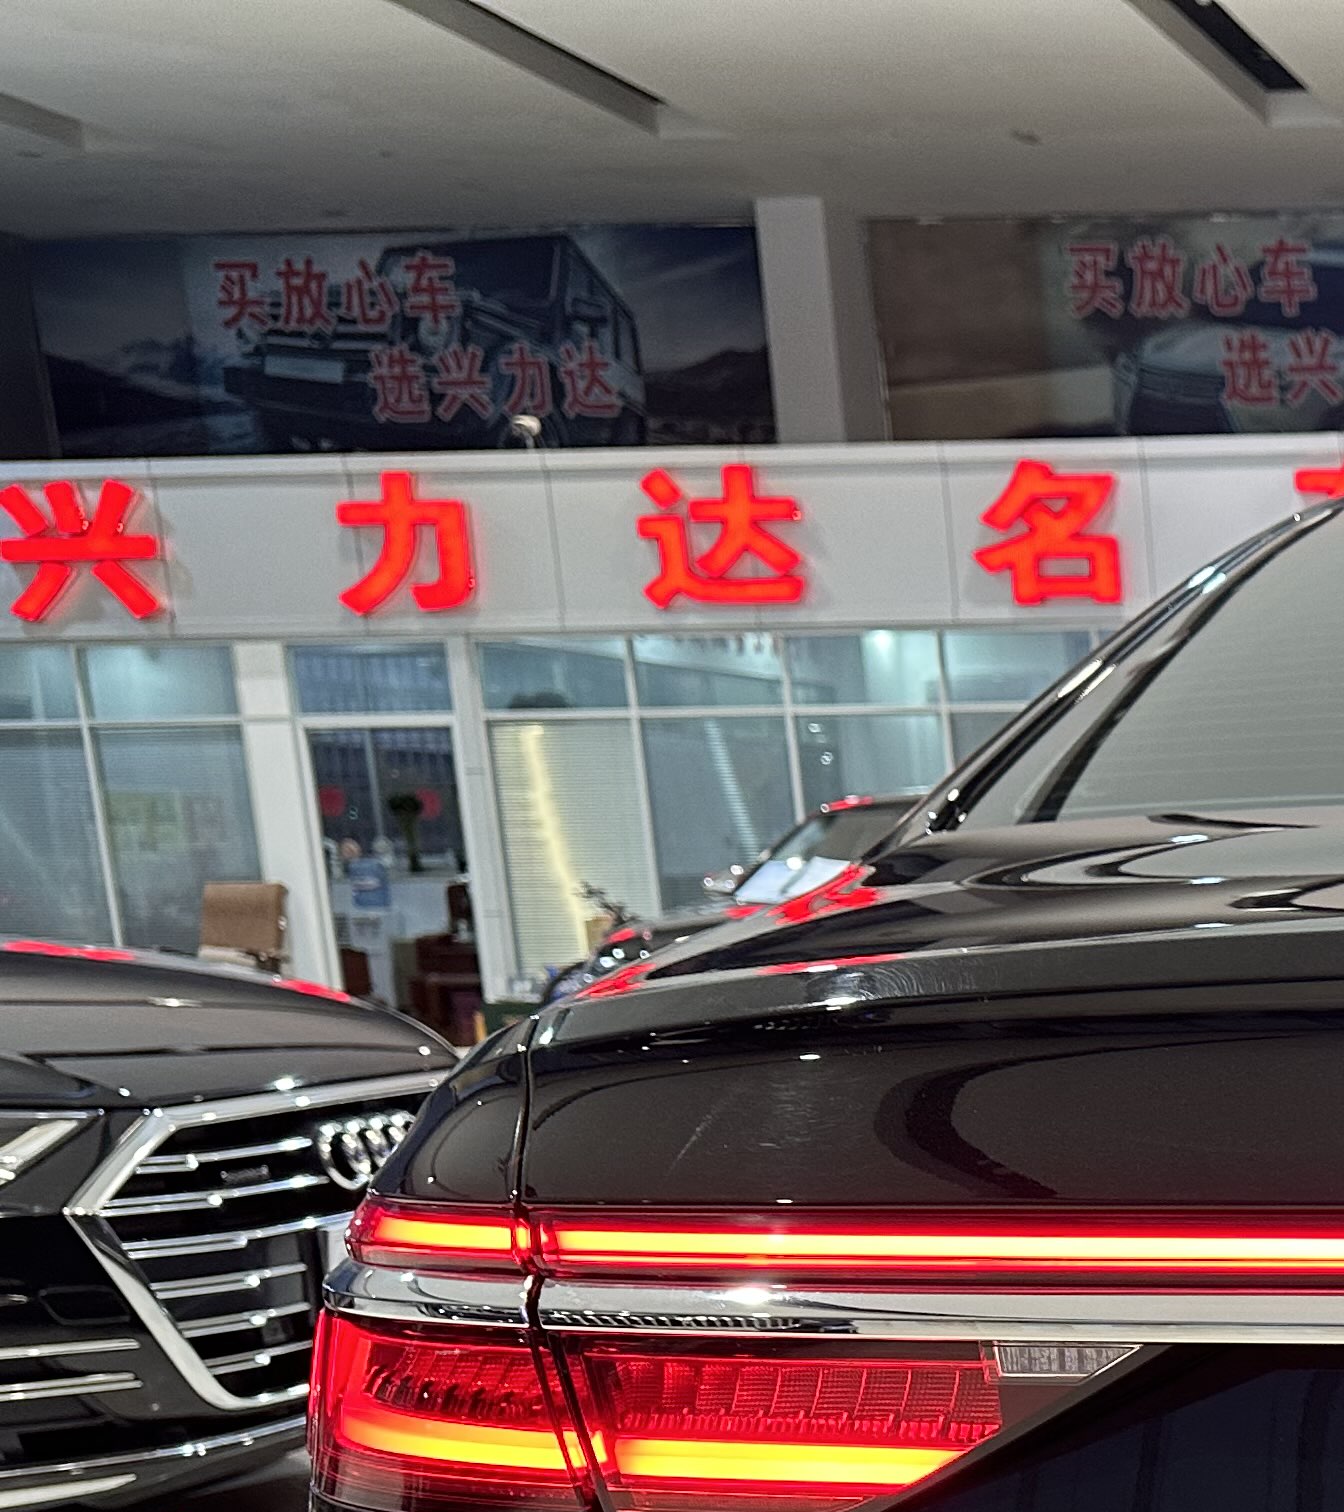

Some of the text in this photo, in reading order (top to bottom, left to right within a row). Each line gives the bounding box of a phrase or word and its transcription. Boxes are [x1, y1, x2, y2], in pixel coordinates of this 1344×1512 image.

[214, 250, 462, 331] 买放心车
[1063, 237, 1319, 318] 买放心车
[368, 341, 624, 424] 选兴力达
